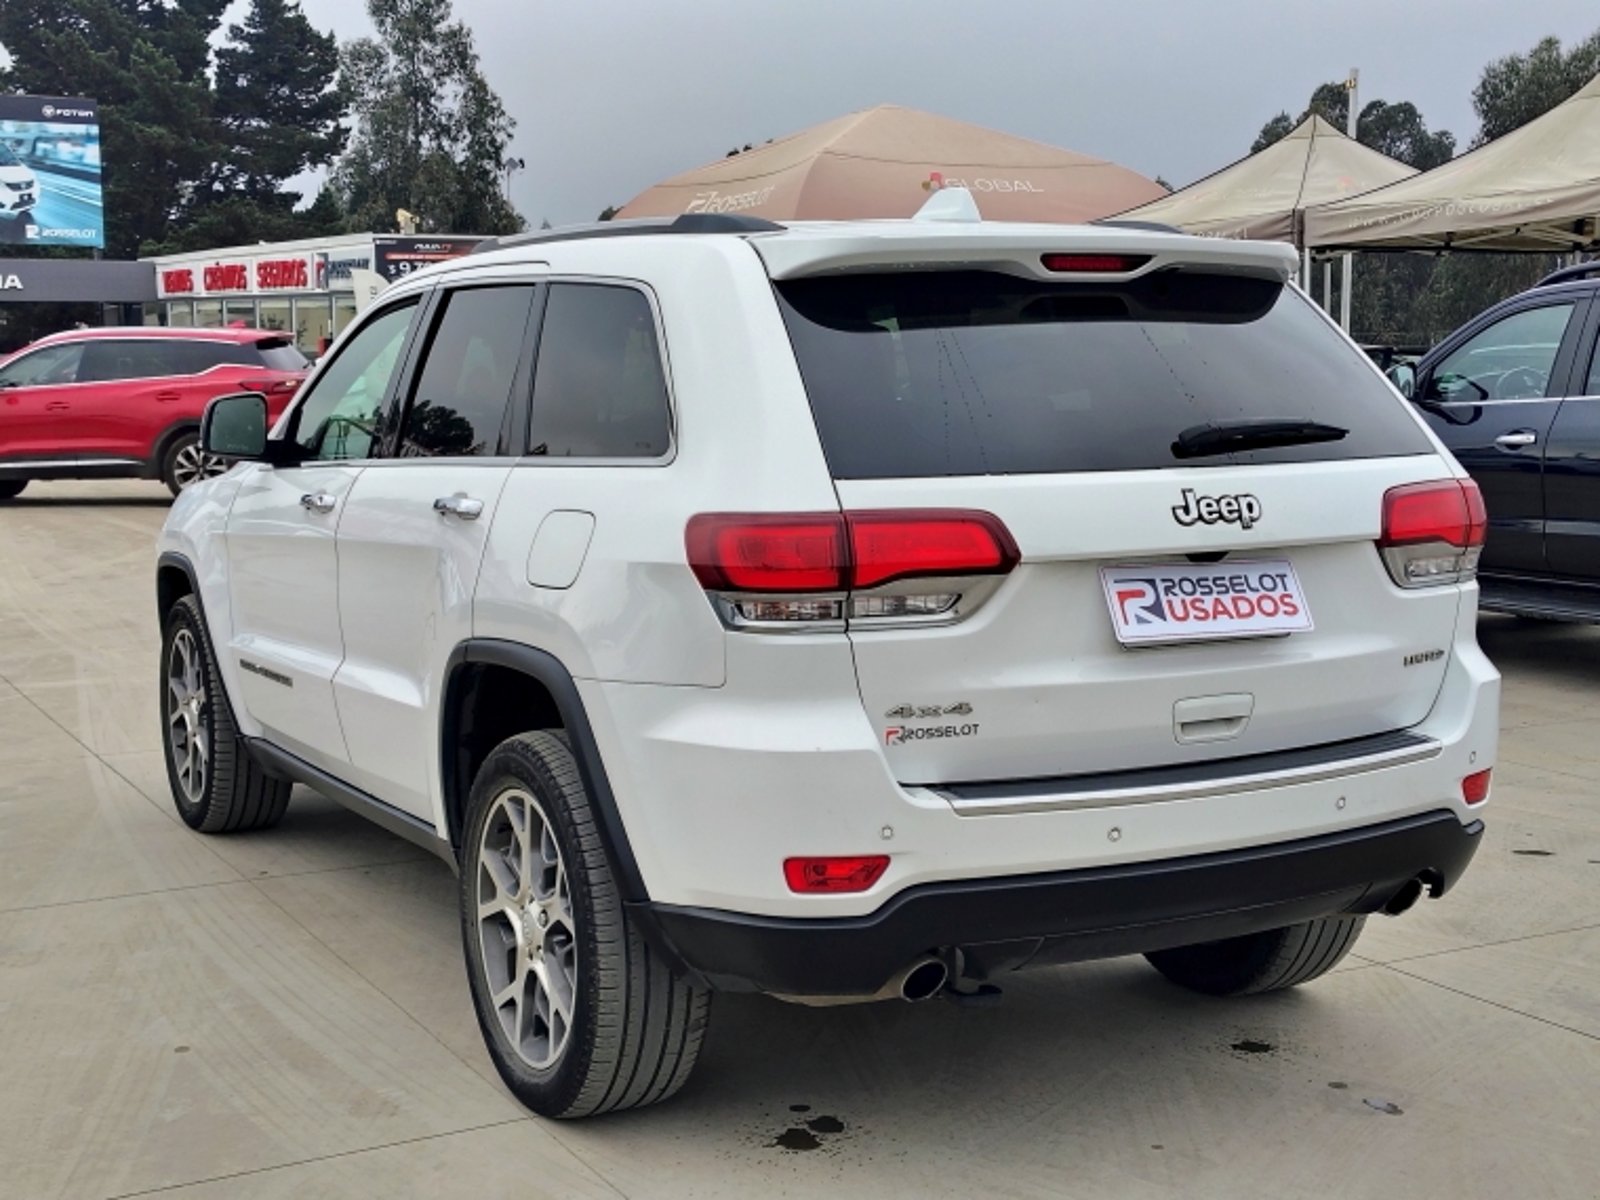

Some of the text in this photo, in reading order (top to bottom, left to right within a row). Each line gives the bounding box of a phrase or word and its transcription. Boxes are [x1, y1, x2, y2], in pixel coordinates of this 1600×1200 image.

[1171, 488, 1261, 530] Jeep
[1161, 573, 1288, 597] ROSSELOT
[1166, 593, 1299, 622] USADOS
[904, 723, 980, 740] ROSSELOT
